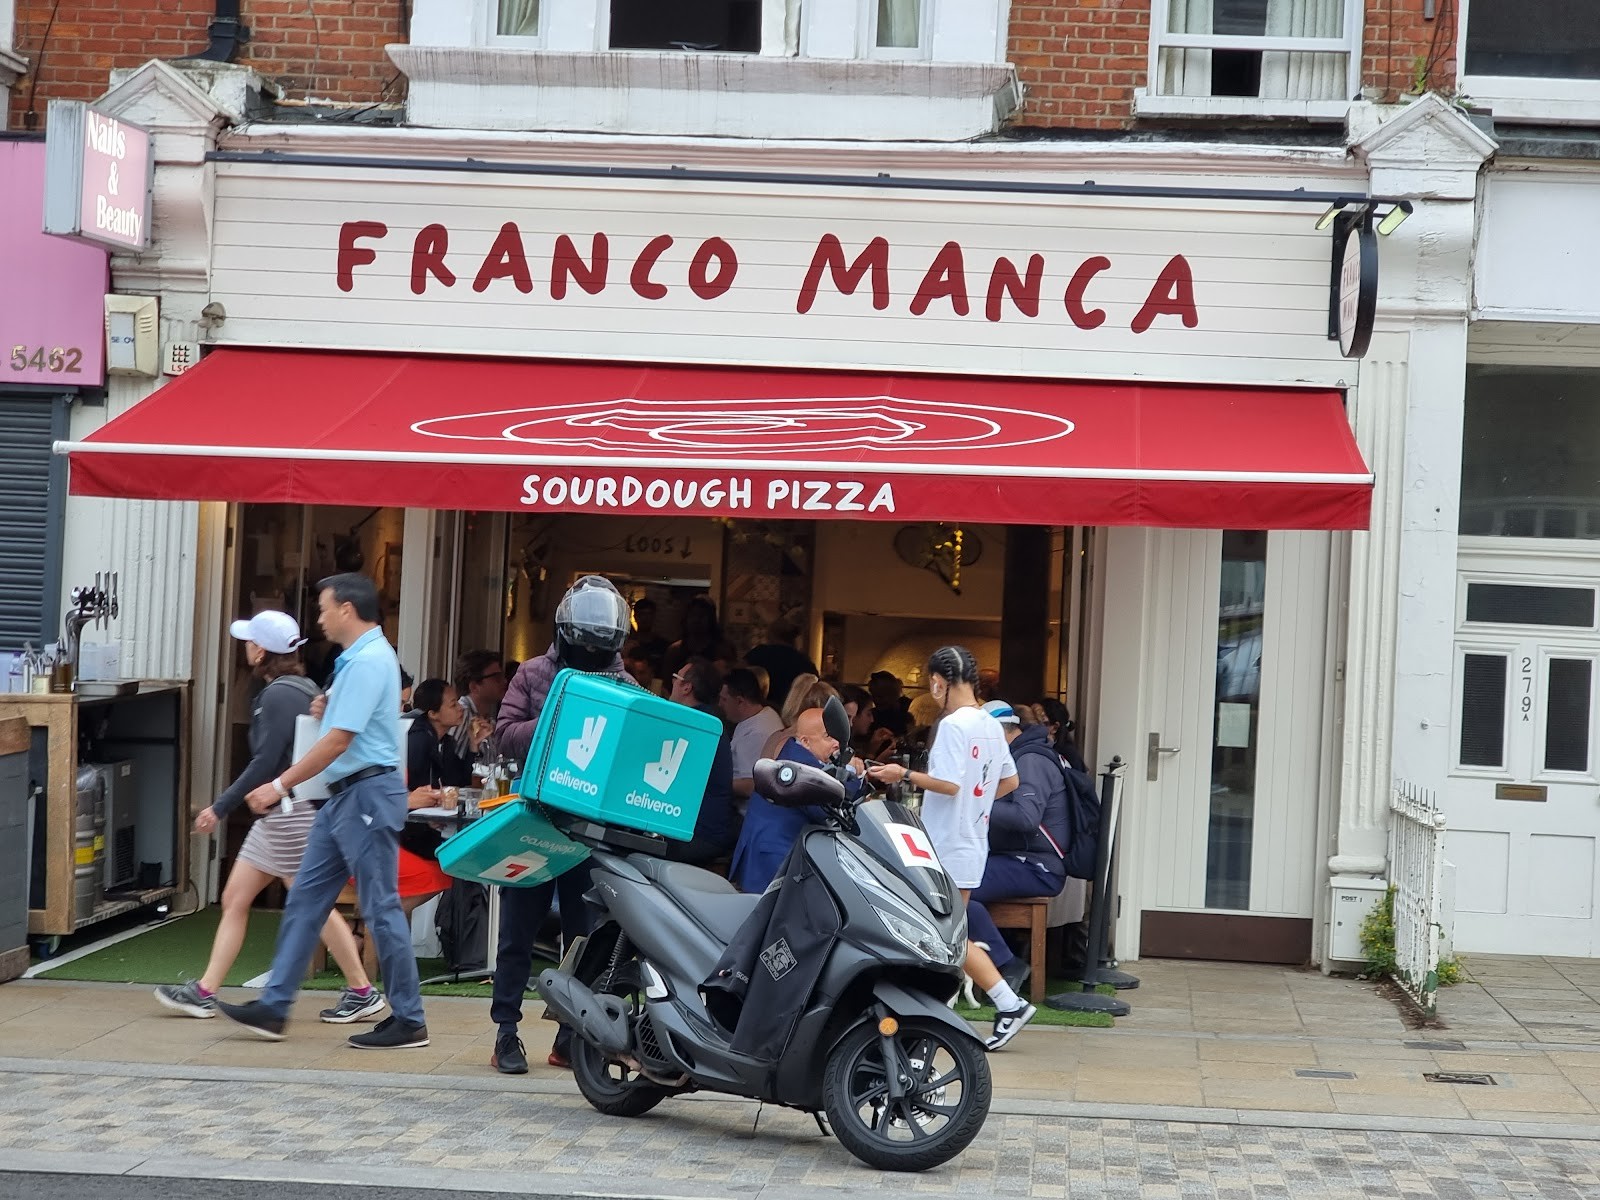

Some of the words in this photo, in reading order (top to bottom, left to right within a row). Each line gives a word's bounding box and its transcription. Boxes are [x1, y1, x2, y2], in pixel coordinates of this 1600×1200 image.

[87, 110, 126, 160] Nails
[107, 161, 119, 196] &
[96, 194, 143, 245] Beauty
[336, 221, 738, 300] FRANCO
[796, 233, 1199, 334] MANCA
[10, 344, 82, 373] 5462
[520, 474, 752, 509] SOURDOUGH
[766, 479, 896, 513] PIZZA
[625, 535, 673, 554] LOOS
[549, 767, 598, 796] deliveroo
[625, 790, 682, 818] deliveroo
[901, 833, 932, 861] L
